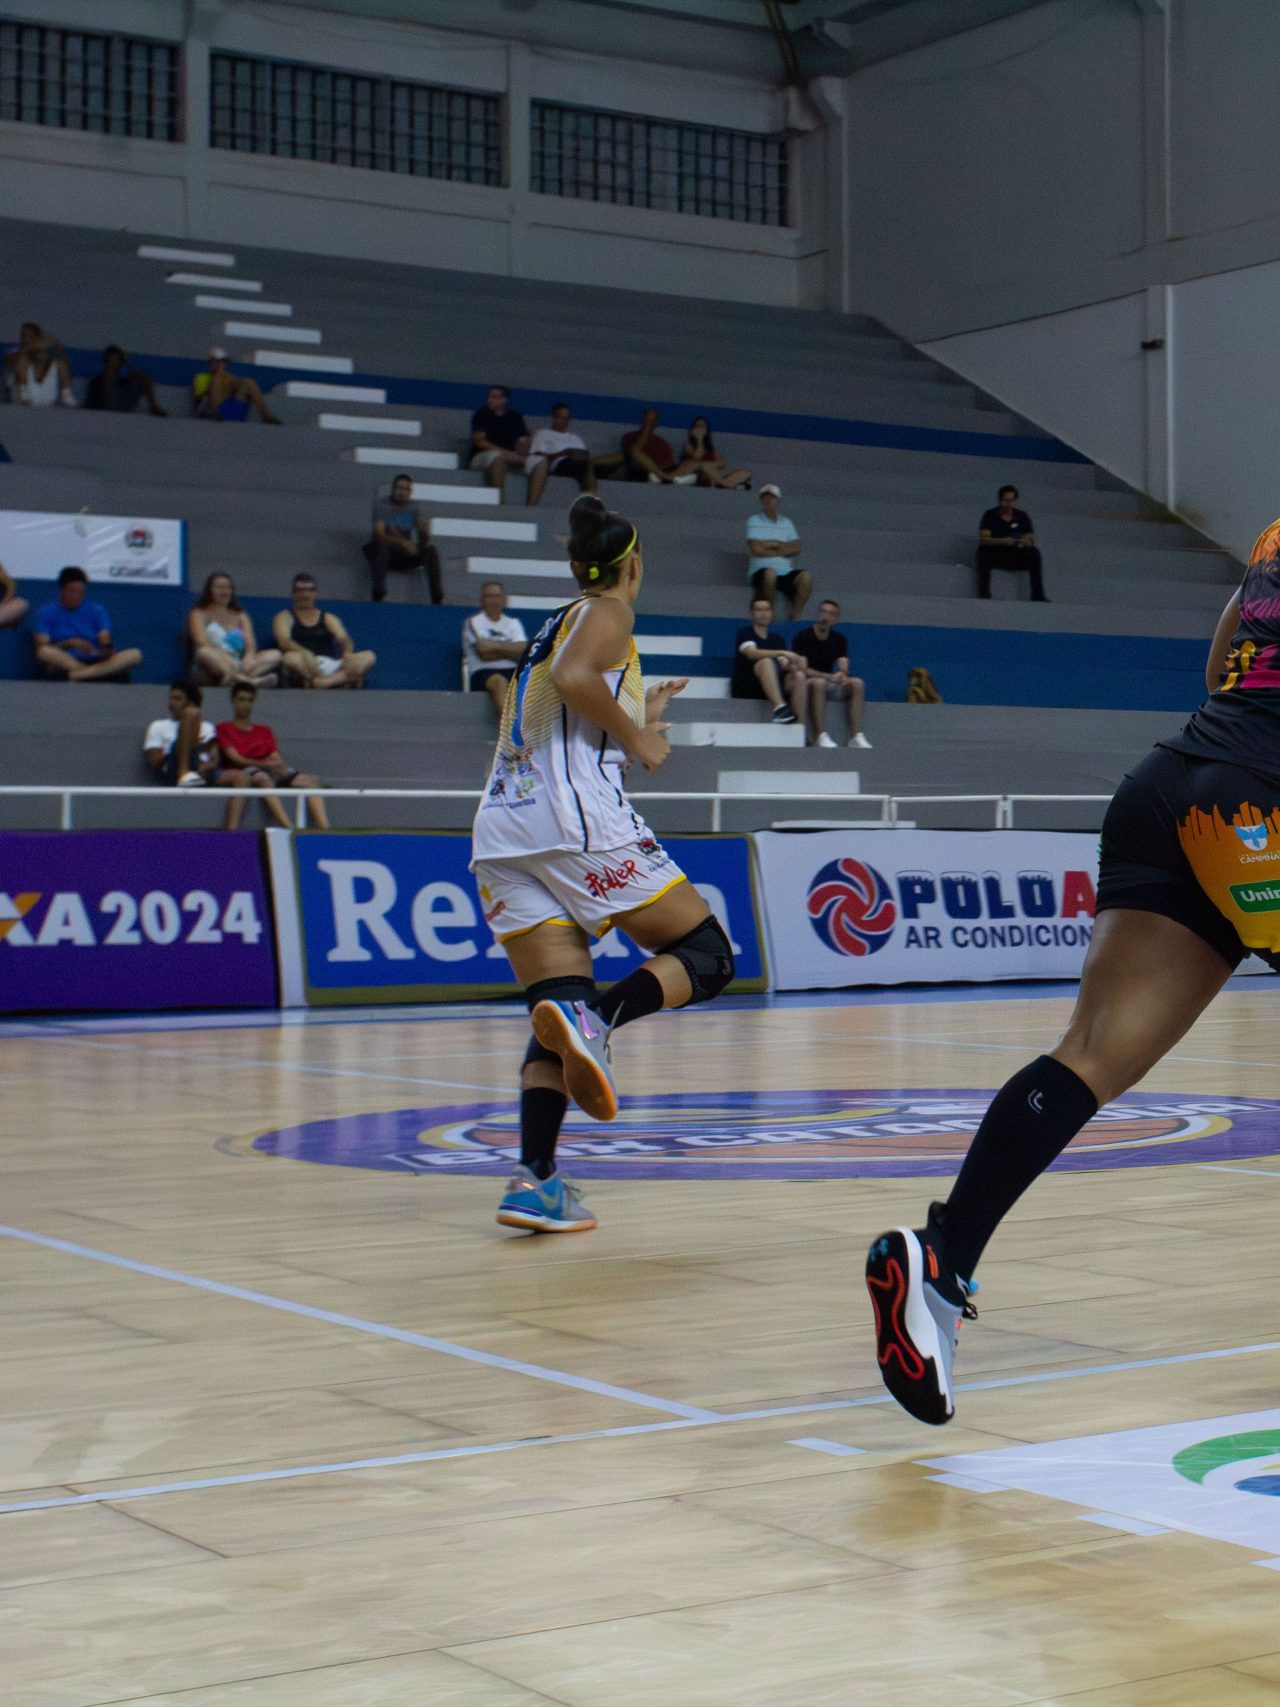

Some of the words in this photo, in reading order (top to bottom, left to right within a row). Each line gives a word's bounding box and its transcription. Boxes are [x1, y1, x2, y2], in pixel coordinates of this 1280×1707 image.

[100, 889, 262, 945] 2024
[896, 869, 1097, 919] POLOA
[904, 925, 943, 948] AR
[952, 923, 1095, 948] CONDICION
